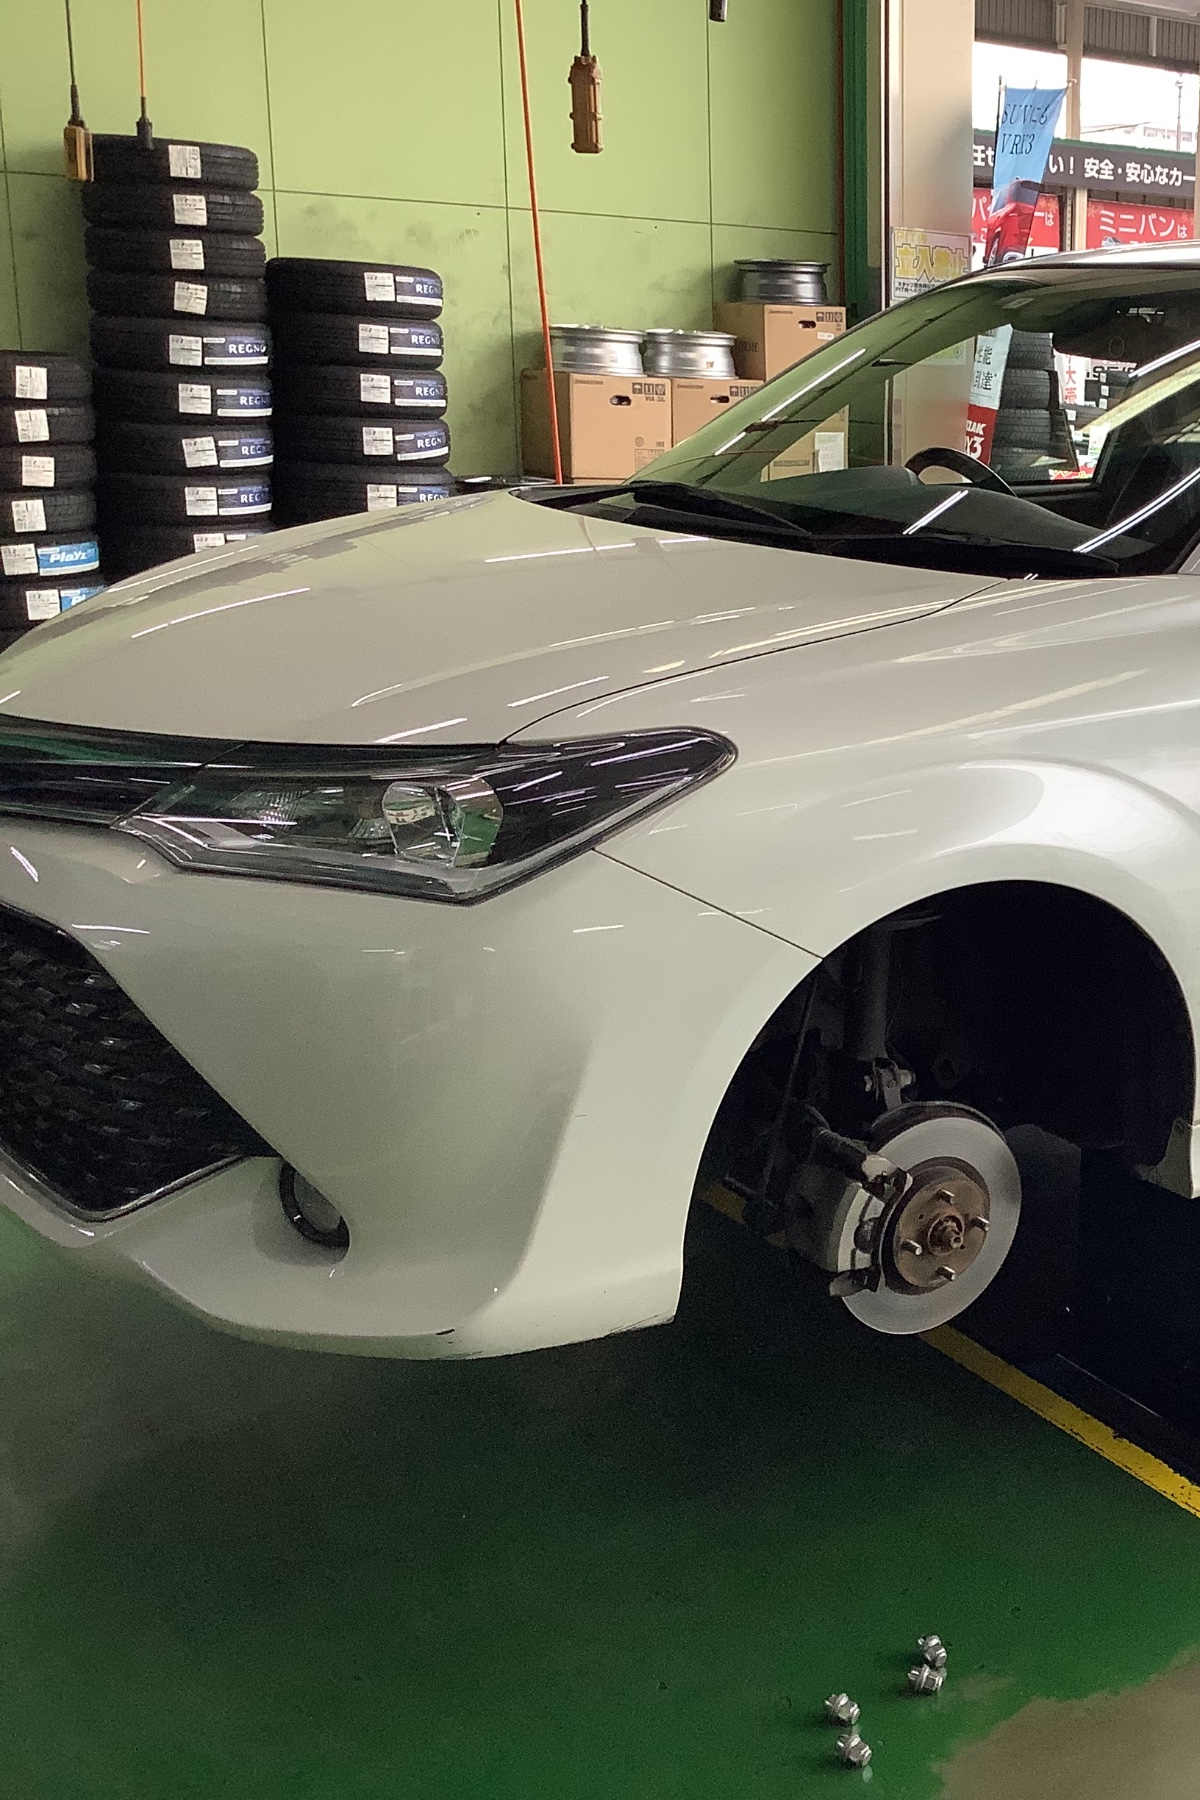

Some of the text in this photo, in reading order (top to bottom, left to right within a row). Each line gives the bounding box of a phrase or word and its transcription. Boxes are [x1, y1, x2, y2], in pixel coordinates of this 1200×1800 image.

[1099, 210, 1188, 239] ミニバンは
